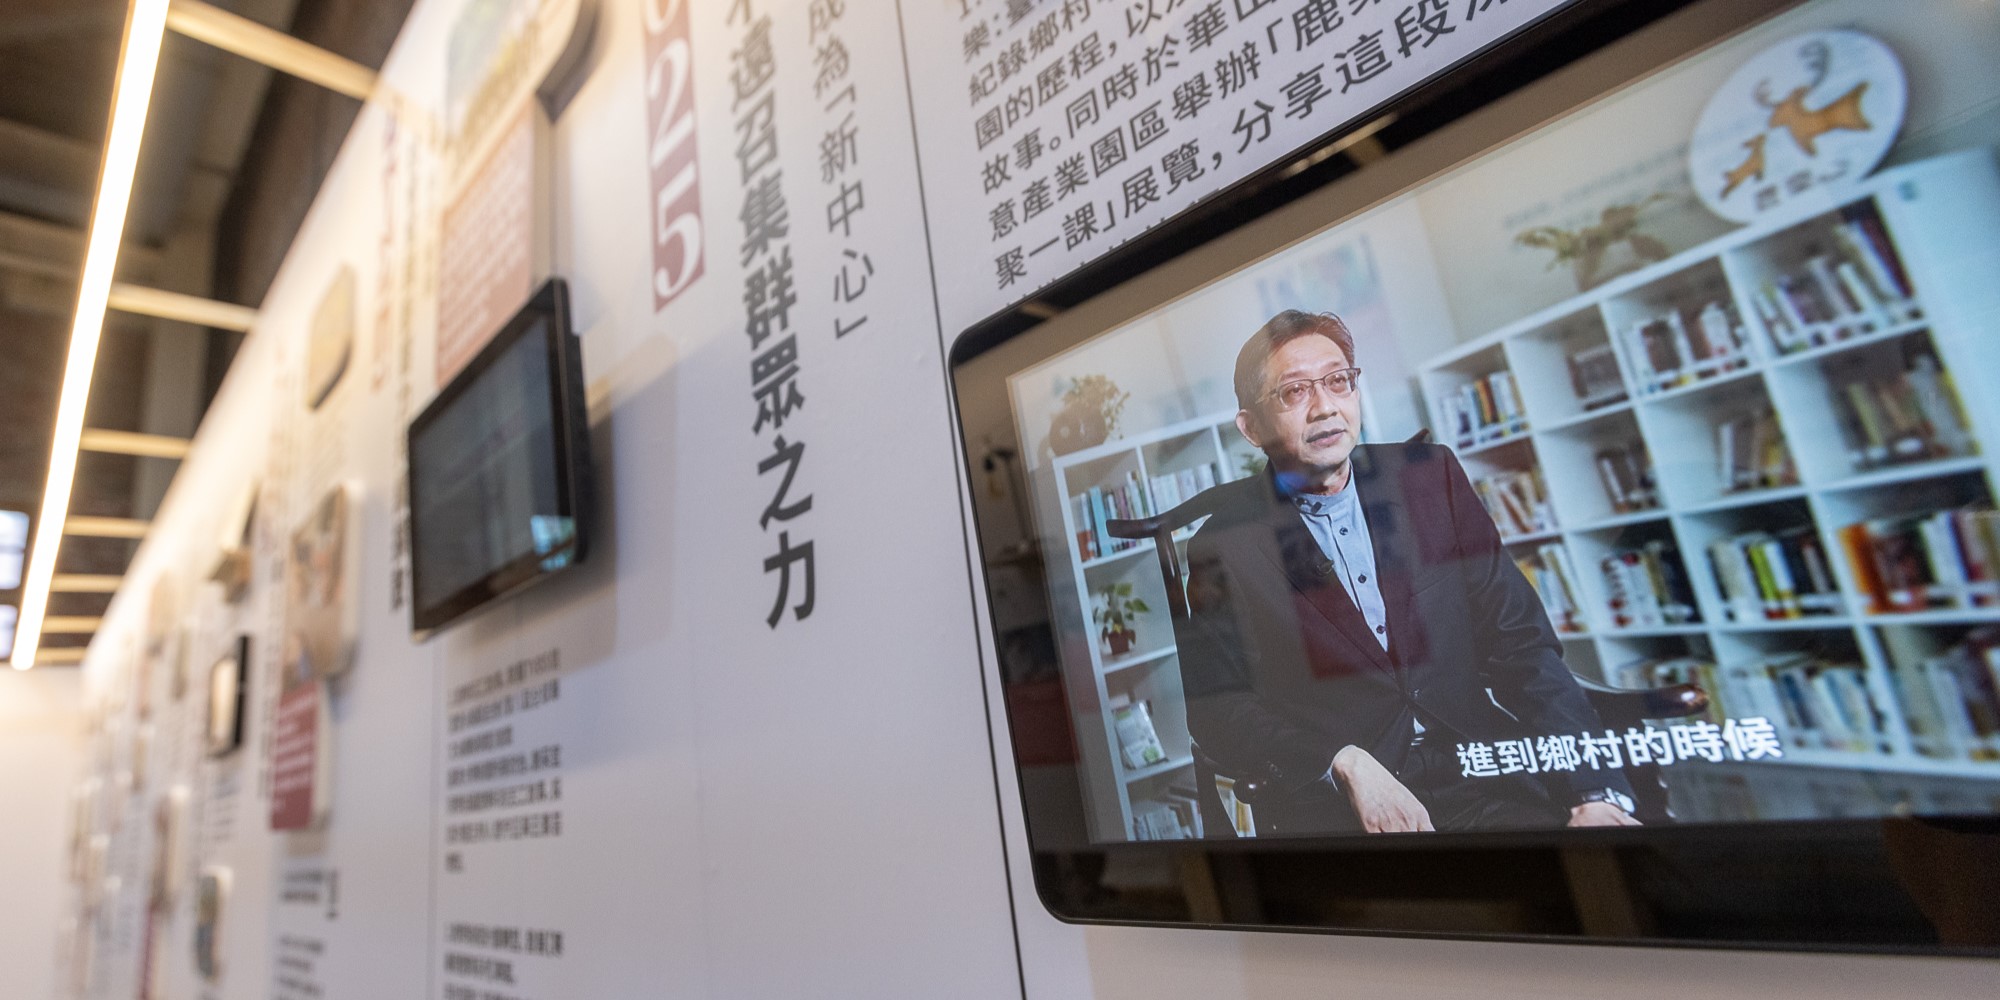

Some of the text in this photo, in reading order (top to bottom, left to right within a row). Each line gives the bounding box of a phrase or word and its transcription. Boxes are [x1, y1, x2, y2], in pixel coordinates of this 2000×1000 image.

[645, 0, 702, 298] 25
[1456, 716, 1783, 778] 進到鄉村的時候
